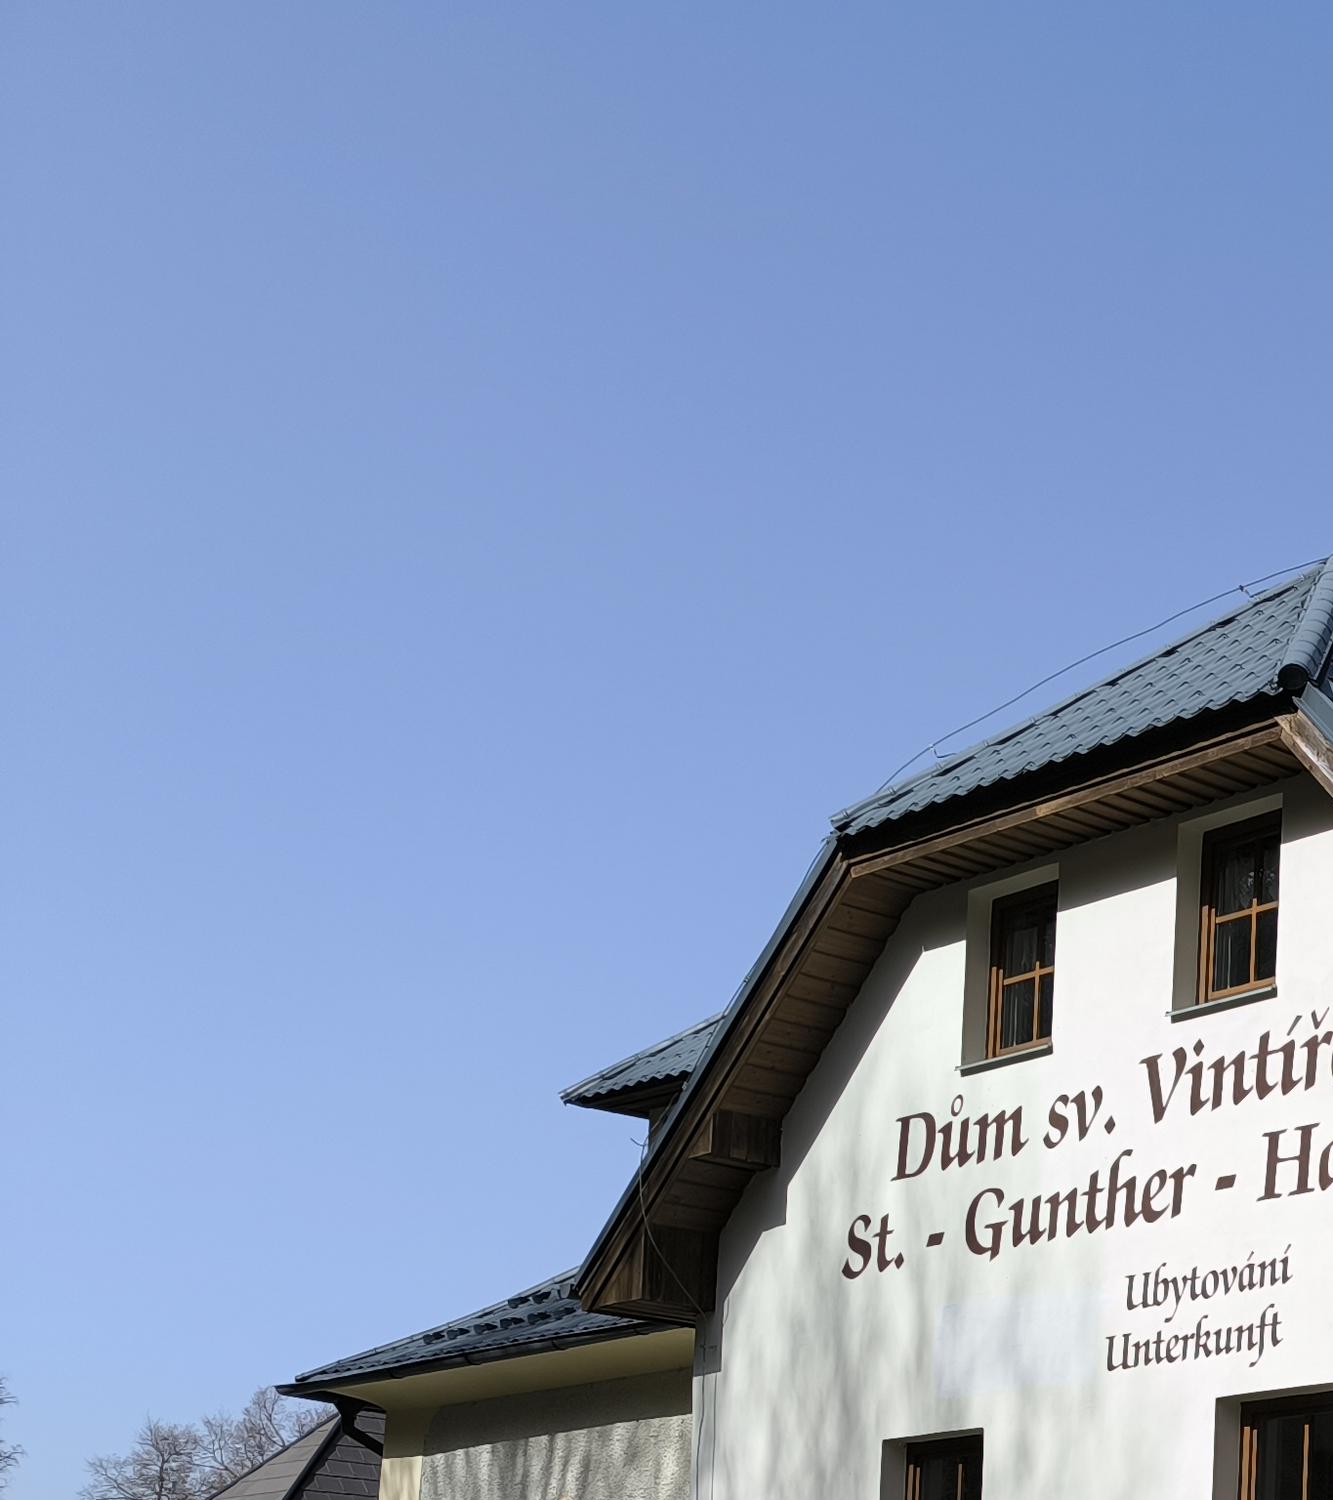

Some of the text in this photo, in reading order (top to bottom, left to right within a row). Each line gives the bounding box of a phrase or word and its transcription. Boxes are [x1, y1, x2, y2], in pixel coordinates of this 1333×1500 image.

[891, 1094, 1029, 1182] Dům
[1043, 1085, 1116, 1150] sv.
[841, 1213, 905, 1280] St.
[965, 1148, 1197, 1261] Gunther
[1125, 1243, 1294, 1323] Ubytování
[1105, 1303, 1284, 1372] Unterkunft
